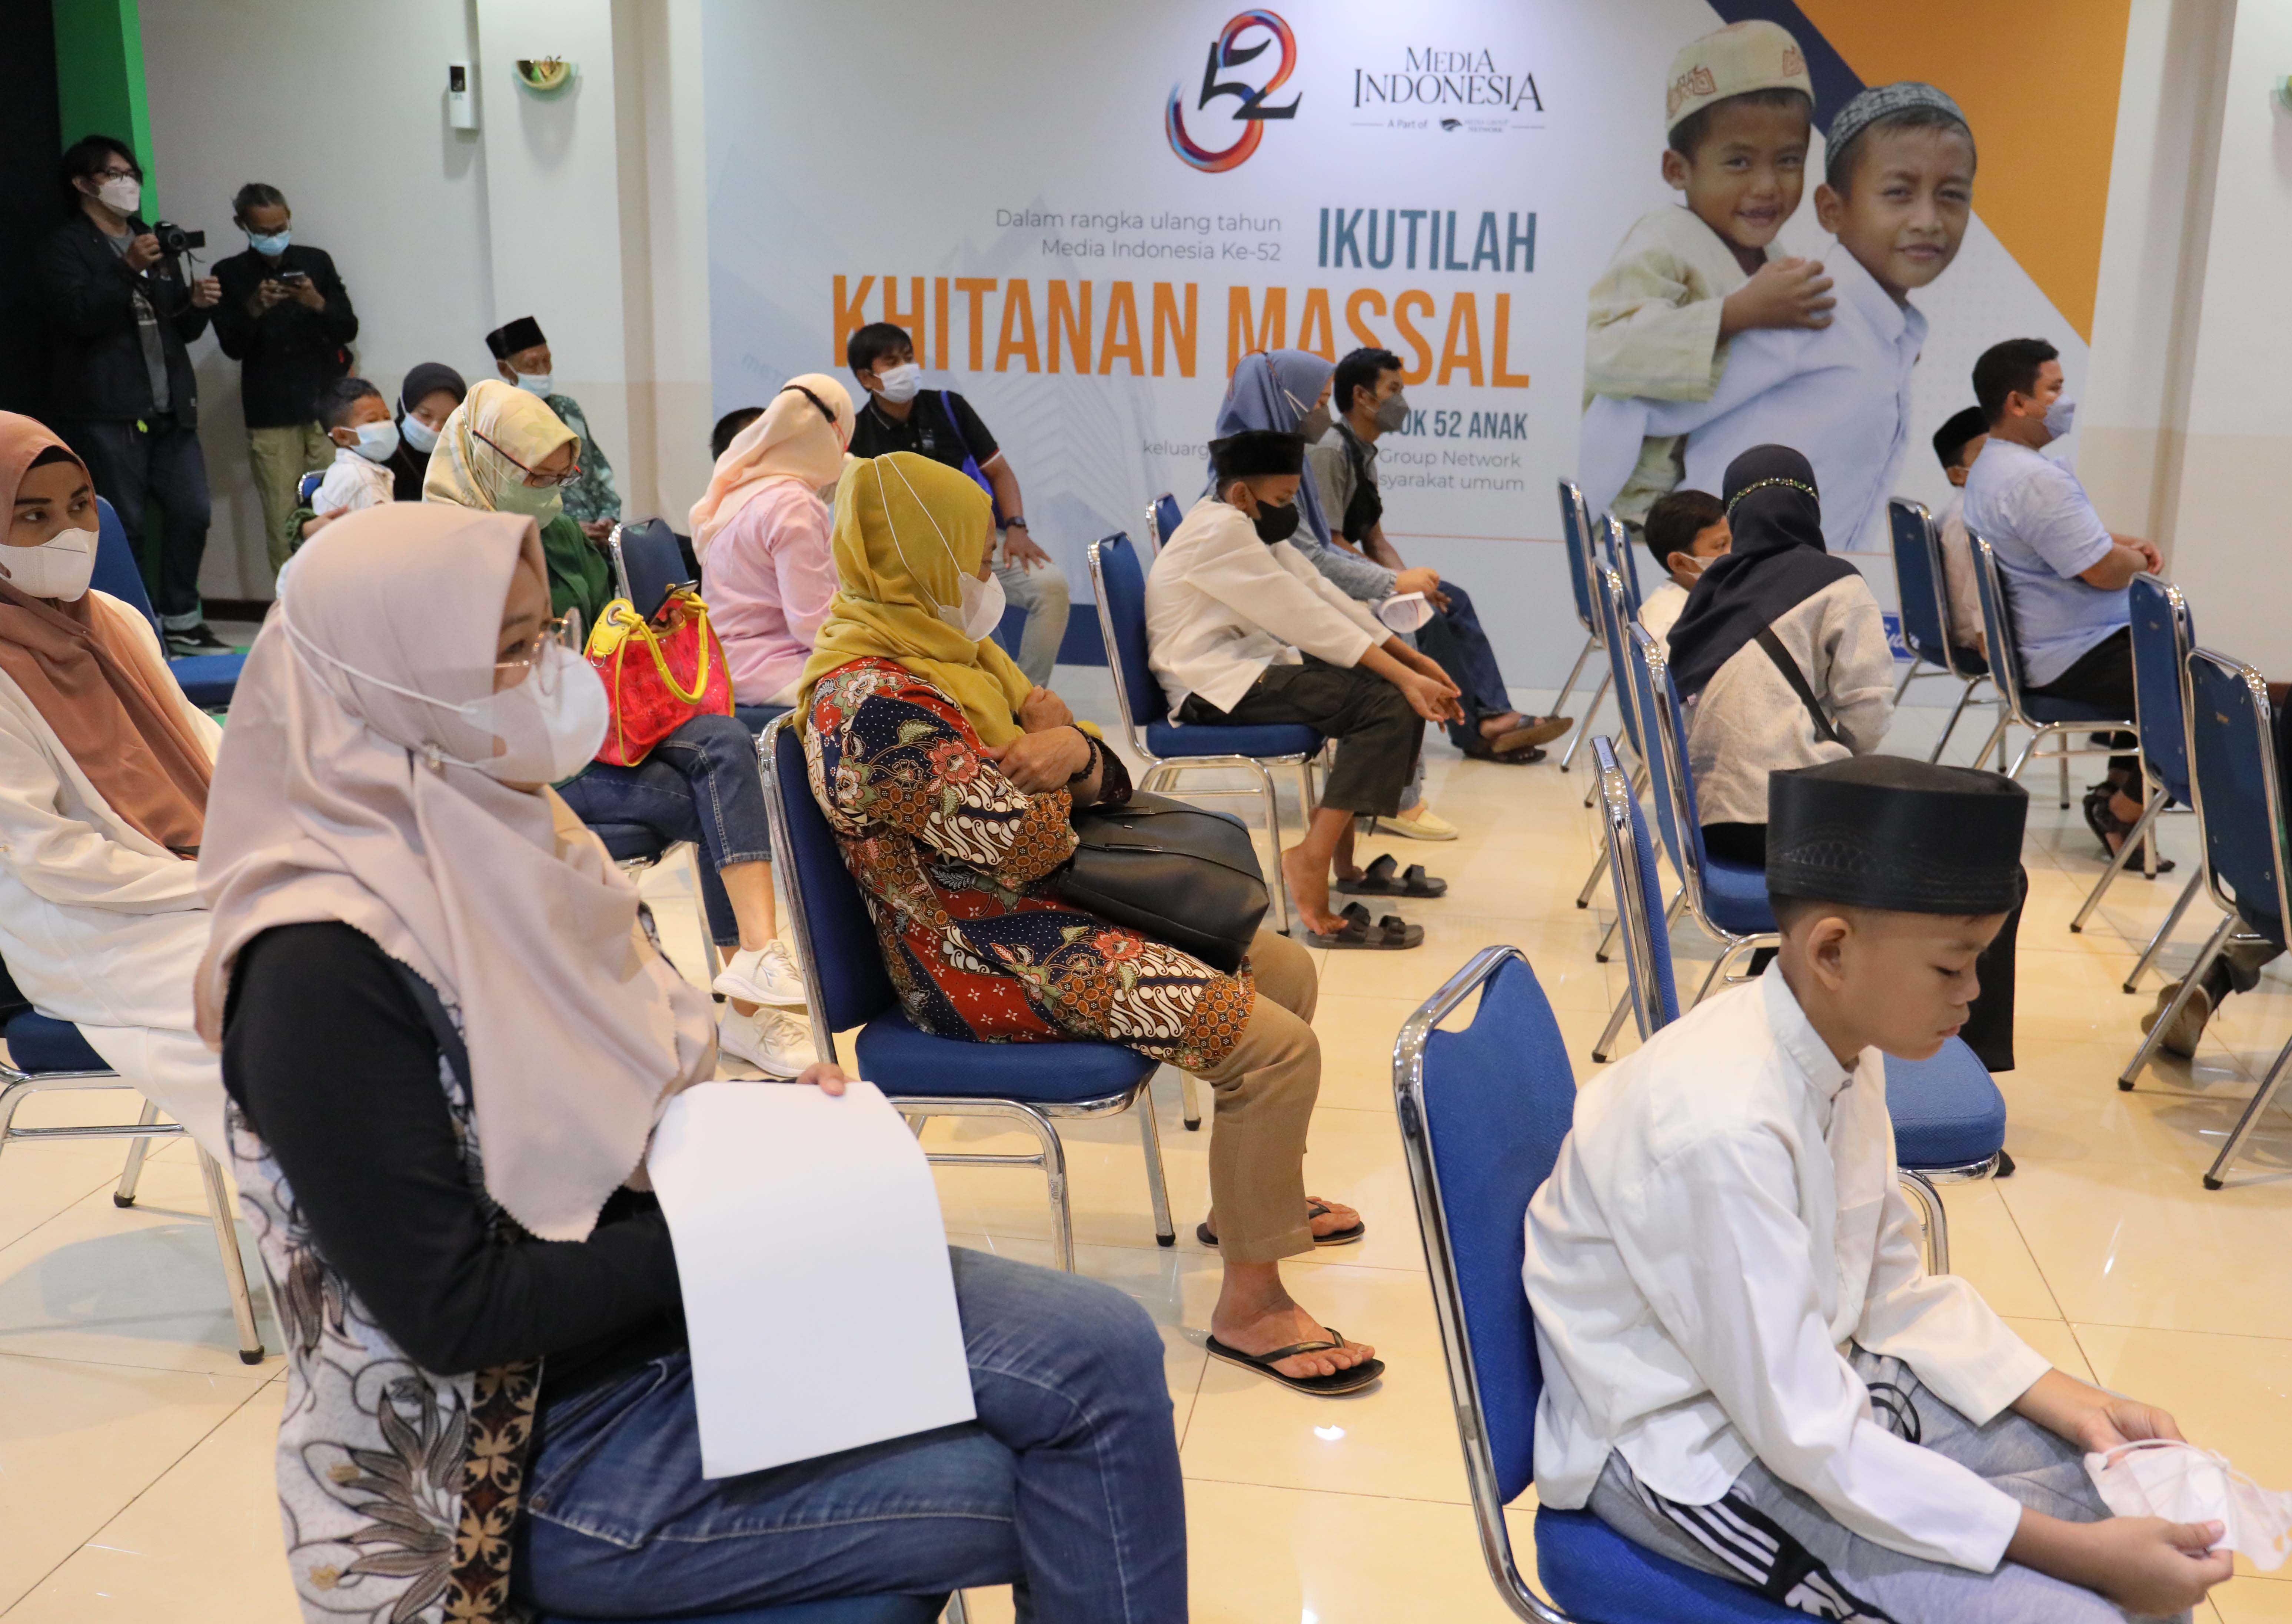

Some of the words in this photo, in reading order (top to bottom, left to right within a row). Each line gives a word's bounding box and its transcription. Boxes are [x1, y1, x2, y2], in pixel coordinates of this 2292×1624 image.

[1405, 47, 1495, 73] MEDIA
[1165, 9, 1303, 173] 52
[1354, 69, 1544, 112] INDONESIA
[1387, 120, 1394, 128] A
[1397, 120, 1415, 129] Part
[1417, 120, 1428, 129] of
[996, 208, 1064, 228] Dalam
[1071, 210, 1144, 233] rangka
[1151, 211, 1211, 235] ulang
[1217, 213, 1281, 232] tahun
[1042, 238, 1105, 257] Media
[1112, 239, 1214, 260] Indonesia
[1222, 241, 1281, 261] Ke-52
[1318, 207, 1537, 273] IKUTILAH
[833, 274, 1198, 379] KHITANAN
[1226, 286, 1529, 388] MASSAL
[1434, 410, 1462, 438] 52
[1468, 411, 1528, 440] ANAK
[1143, 439, 1210, 460] keluarg
[1378, 448, 1437, 468] Group
[1443, 450, 1521, 468] Network
[1378, 472, 1454, 490] syarakat
[1460, 477, 1525, 492] umum
